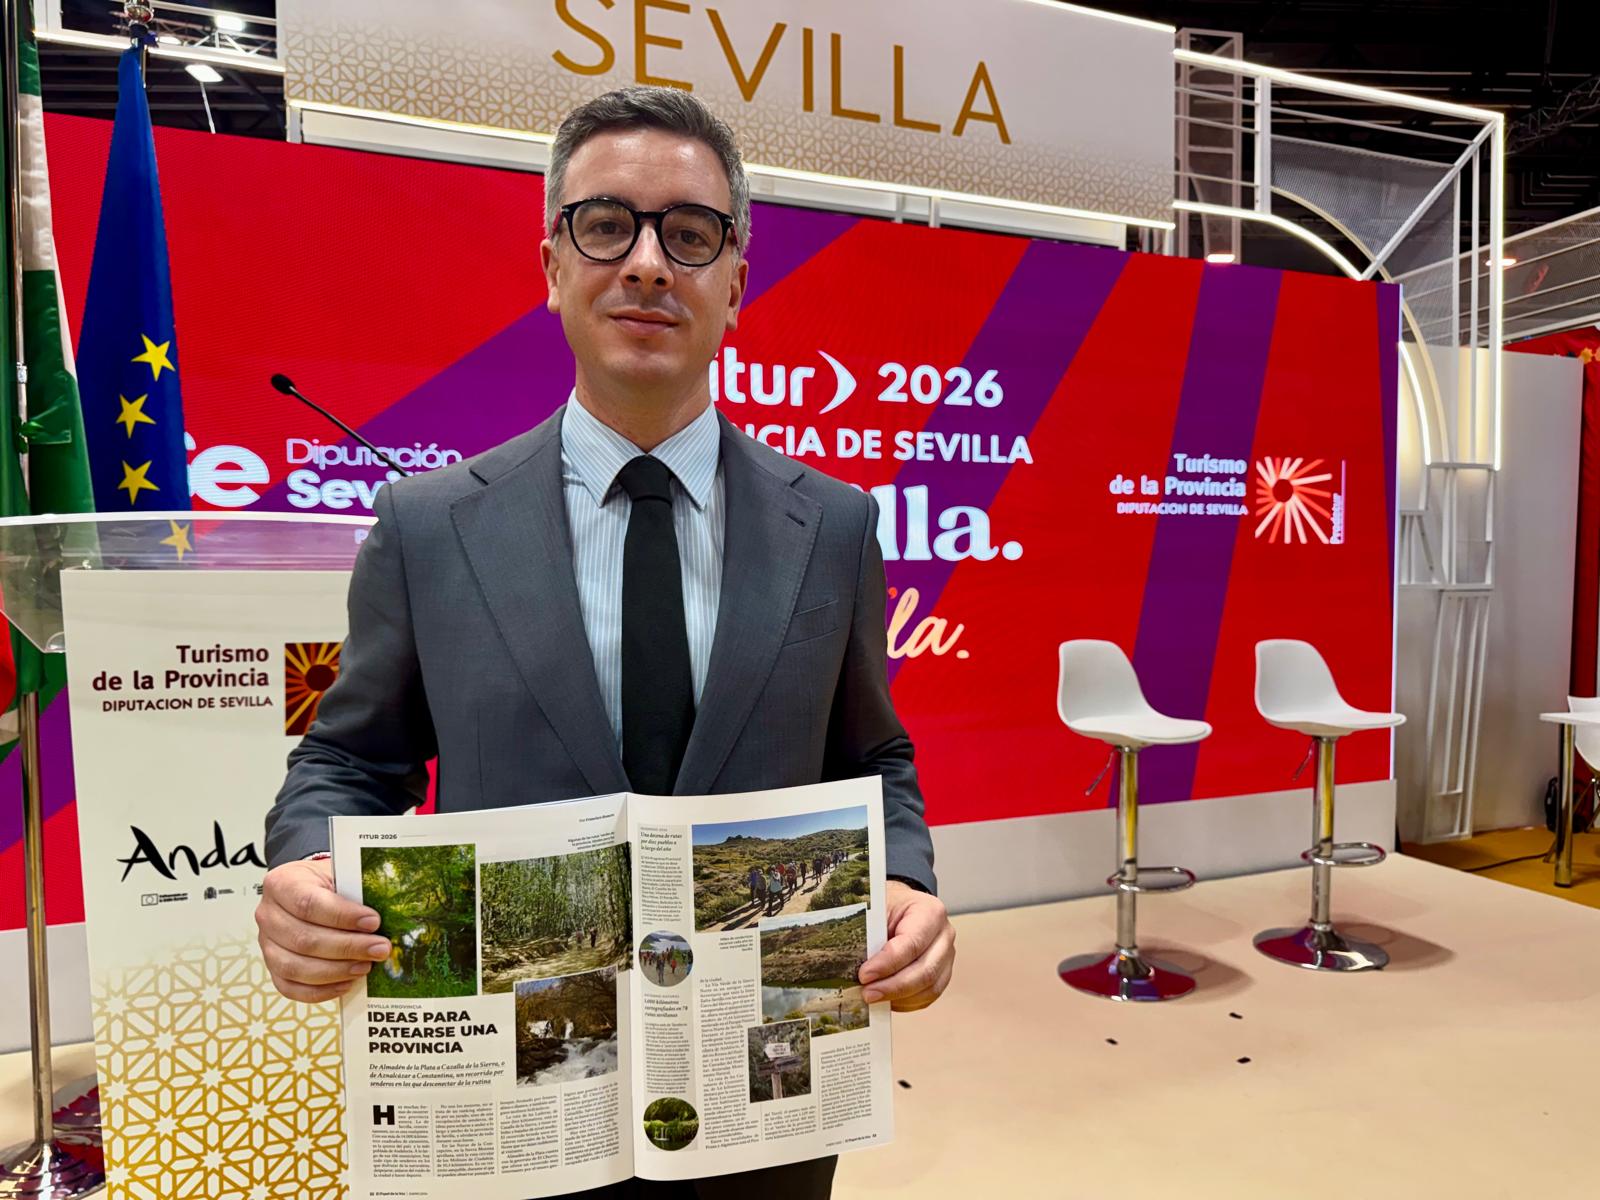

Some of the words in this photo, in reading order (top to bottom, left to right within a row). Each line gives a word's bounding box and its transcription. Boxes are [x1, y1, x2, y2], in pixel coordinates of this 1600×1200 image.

[552, 0, 1011, 145] SEVILLA
[878, 363, 1003, 407] 2026
[286, 438, 463, 471] Diputación
[837, 428, 882, 459] DE
[893, 431, 1033, 464] SEVILLA
[1173, 453, 1247, 474] Turismo
[1109, 474, 1135, 495] de
[1140, 475, 1159, 495] la
[1165, 476, 1246, 497] Provincia
[1117, 502, 1187, 515] DIPUTACION
[1189, 503, 1204, 515] DE
[1206, 503, 1249, 516] SEVILLA
[176, 644, 270, 664] Turismo
[92, 671, 123, 691] de
[133, 670, 155, 690] la
[165, 668, 270, 689] Provincia
[103, 698, 193, 712] DIPUTACION
[198, 697, 215, 709] DE
[220, 695, 273, 708] SEVILLA
[116, 820, 268, 882] Anda
[367, 1011, 418, 1023] IDEAS
[423, 1010, 471, 1023] PARA
[368, 1026, 455, 1038] PATEARSE
[460, 1023, 498, 1037] UNA
[369, 1041, 463, 1054] PROVINCIA
